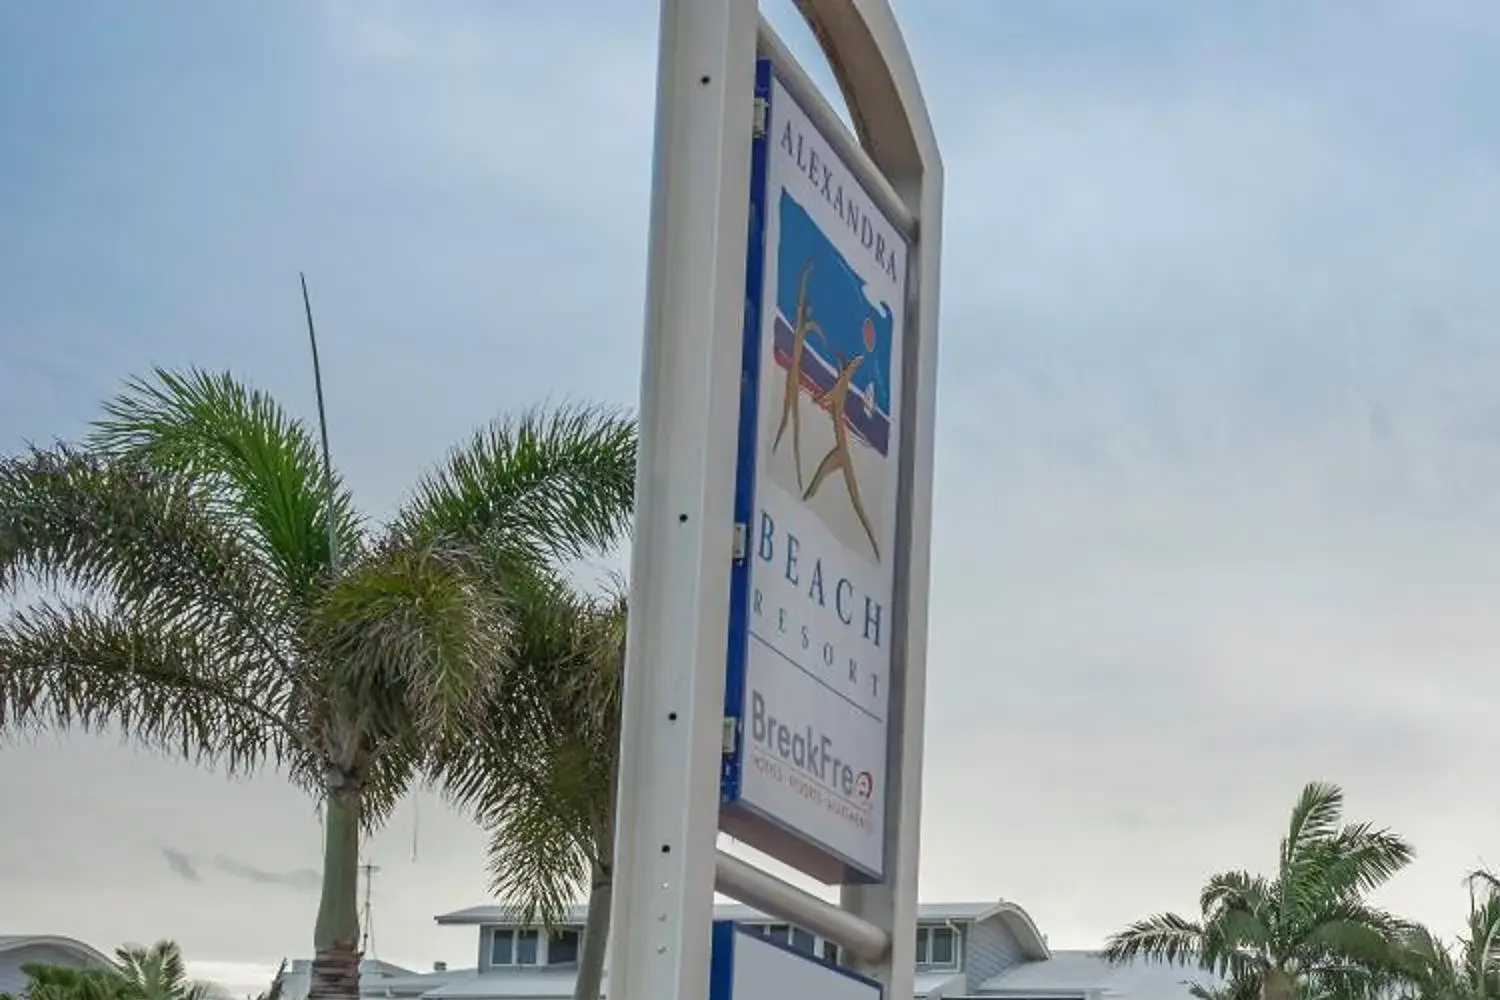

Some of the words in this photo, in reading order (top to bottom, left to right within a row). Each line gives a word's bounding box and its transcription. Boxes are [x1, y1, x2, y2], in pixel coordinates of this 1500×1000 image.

[780, 118, 898, 284] ALEXANDRA
[752, 588, 880, 699] RESORT
[758, 509, 882, 648] BEACH
